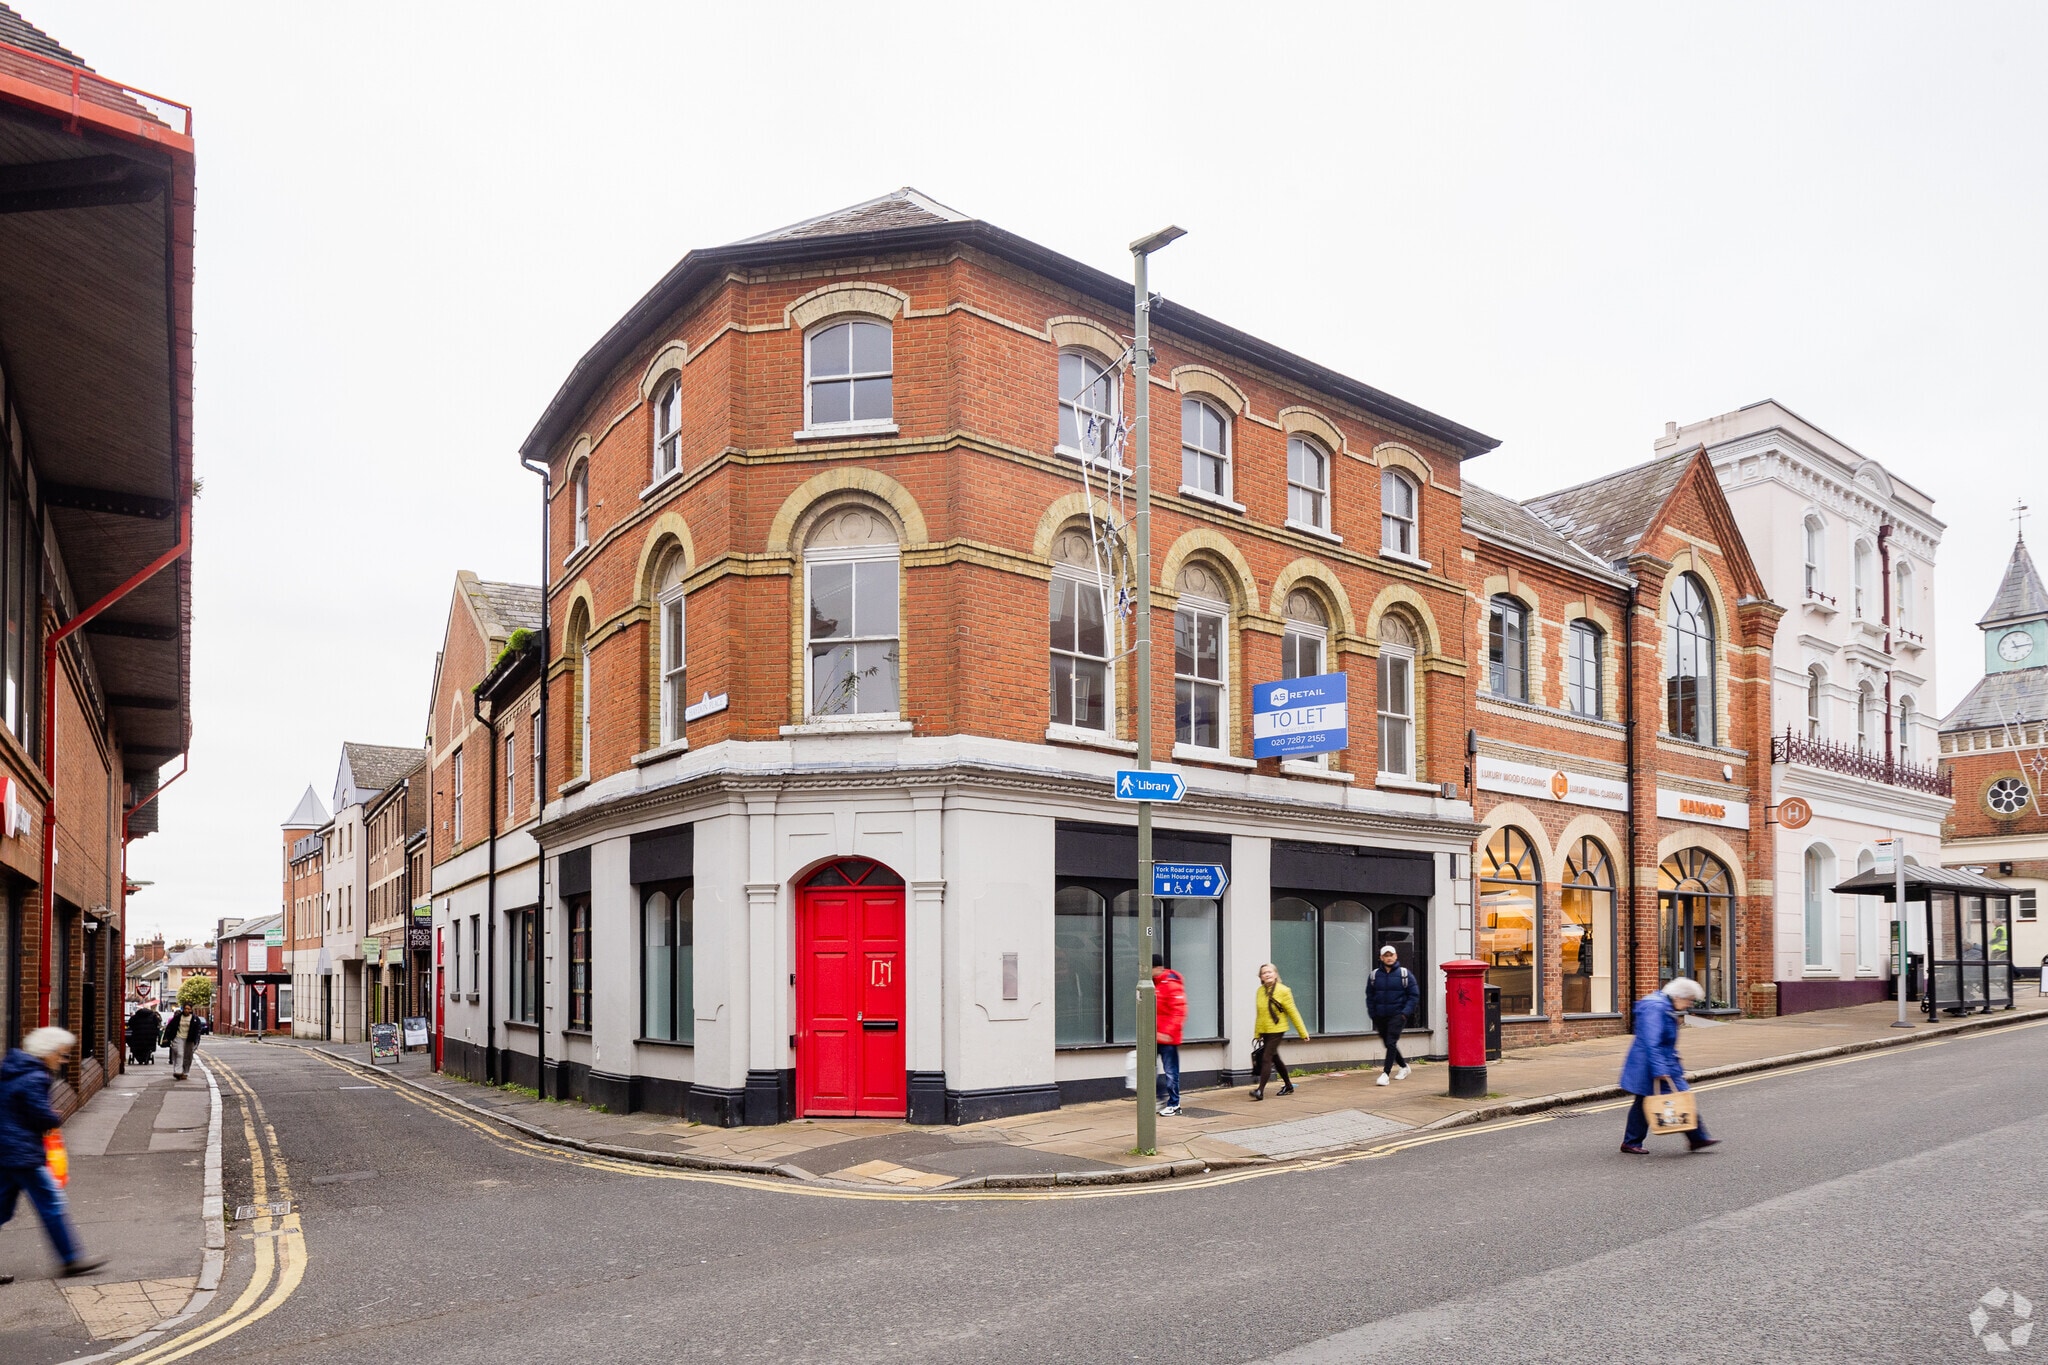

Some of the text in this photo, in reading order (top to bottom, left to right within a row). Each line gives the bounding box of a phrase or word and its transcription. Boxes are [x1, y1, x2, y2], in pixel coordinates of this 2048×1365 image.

[1272, 689, 1325, 702] AS RETAIL
[1270, 707, 1326, 728] TO LET
[1271, 734, 1326, 747] 020 7287 2155
[1481, 769, 1547, 788] LUXURY WOOD FLOORING
[1138, 780, 1170, 792] Library
[1569, 784, 1624, 801] LUXURY WALL CLADDING
[1787, 806, 1799, 820] H
